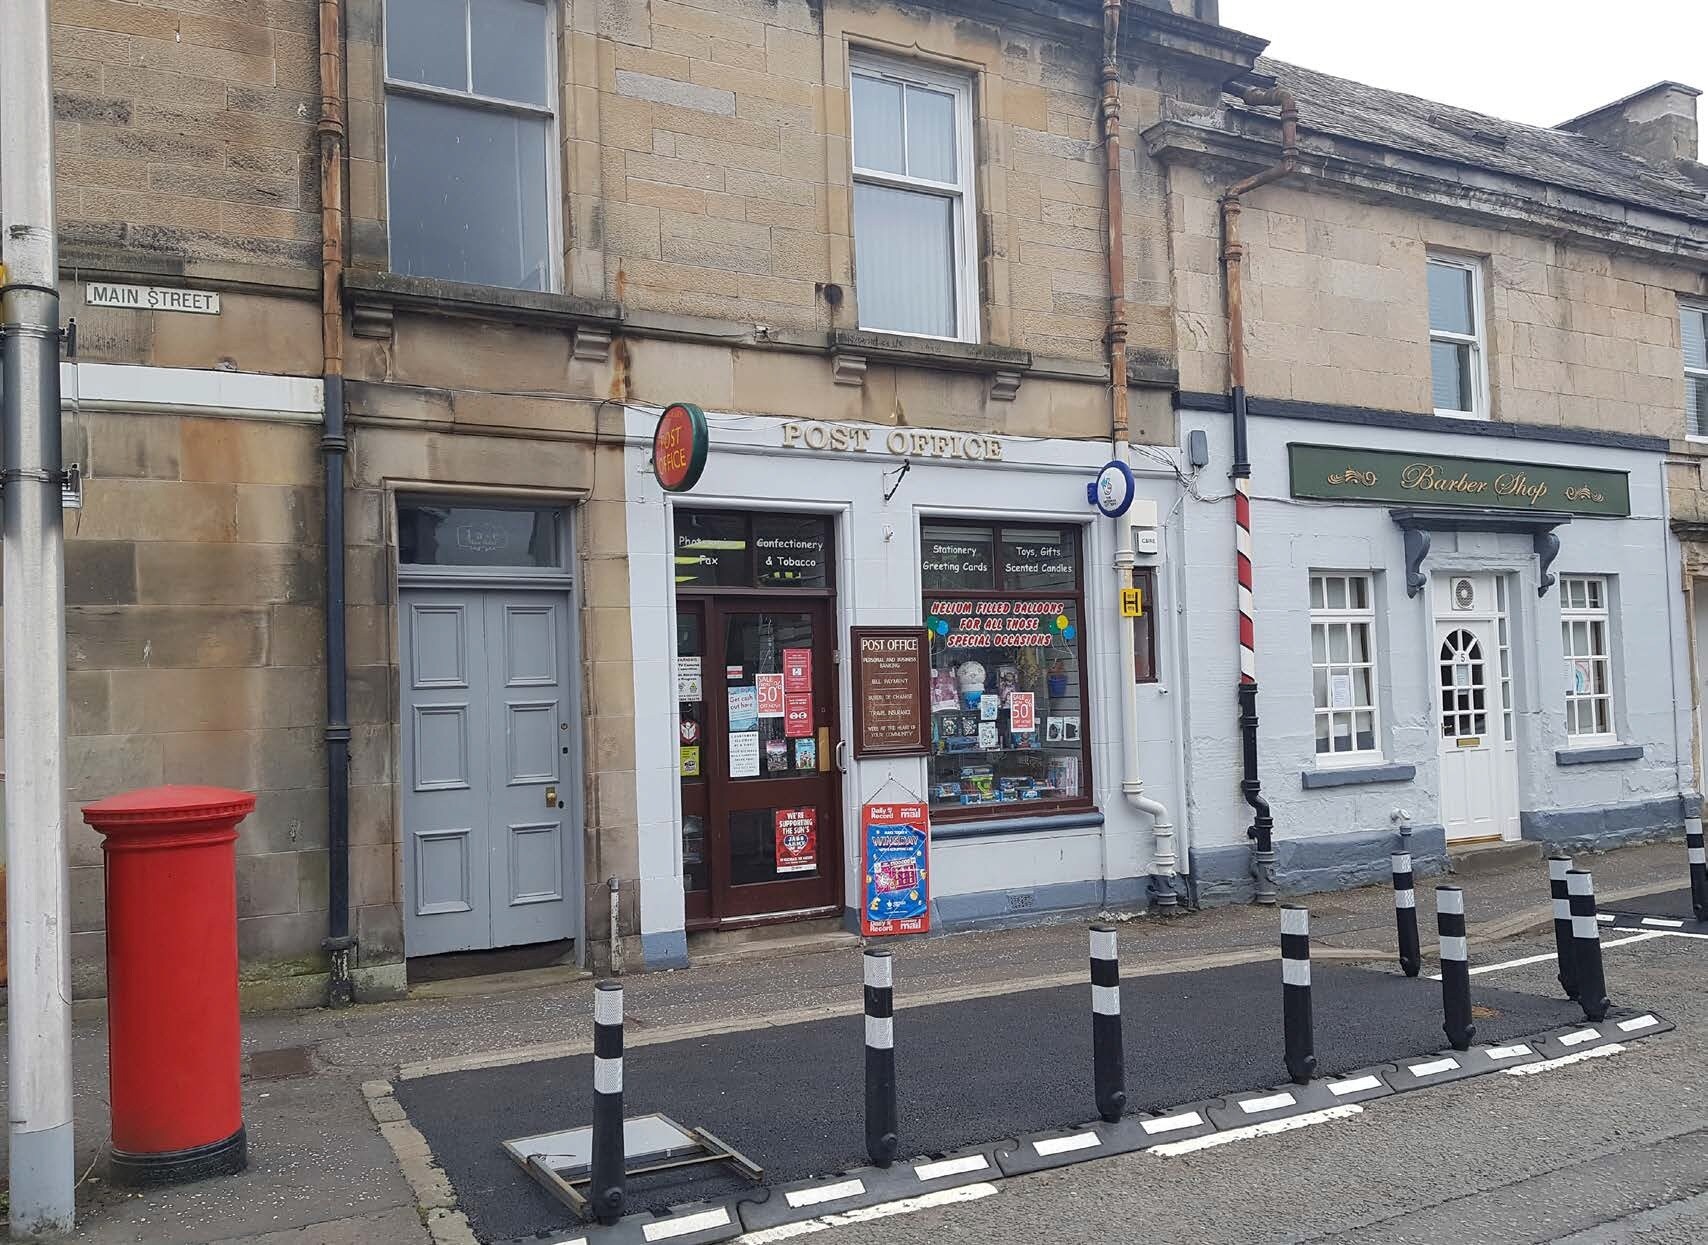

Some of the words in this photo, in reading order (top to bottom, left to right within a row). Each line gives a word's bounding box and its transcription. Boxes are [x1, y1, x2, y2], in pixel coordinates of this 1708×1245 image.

[93, 286, 139, 304] MAIN
[147, 290, 213, 309] STREET
[782, 424, 871, 451] POST
[887, 430, 1003, 460] OFFICE
[1401, 462, 1488, 493] Barber
[1494, 471, 1548, 505] Shop
[756, 538, 824, 551] Confectionery
[932, 544, 977, 557] Stationery
[1015, 546, 1038, 557] Toys,
[1040, 547, 1061, 556] Gifts
[699, 554, 719, 566] Fax
[765, 556, 773, 566] &
[777, 556, 817, 567] Tobacco
[922, 561, 960, 573] Greeting
[962, 562, 988, 572] Cards
[1006, 562, 1039, 573] Scented
[1041, 563, 1073, 573] Candles
[931, 601, 974, 615] HELIUM
[975, 602, 1011, 615] FILLED
[1013, 602, 1065, 616] BALLOONS
[959, 617, 982, 632] FOR
[983, 617, 1003, 631] ALL
[1005, 618, 1040, 631] THOSE
[862, 639, 885, 651] POST
[887, 639, 918, 651] OFFICE
[947, 634, 991, 648] SPECIAL
[993, 633, 1052, 648] OCCASIONS
[758, 686, 777, 703] 50
[1012, 703, 1029, 719] 50
[787, 812, 804, 820] WE'RE
[871, 807, 887, 815] Daily
[900, 808, 921, 819] mail
[779, 819, 813, 828] SUPPORTING
[900, 919, 922, 930] mail
